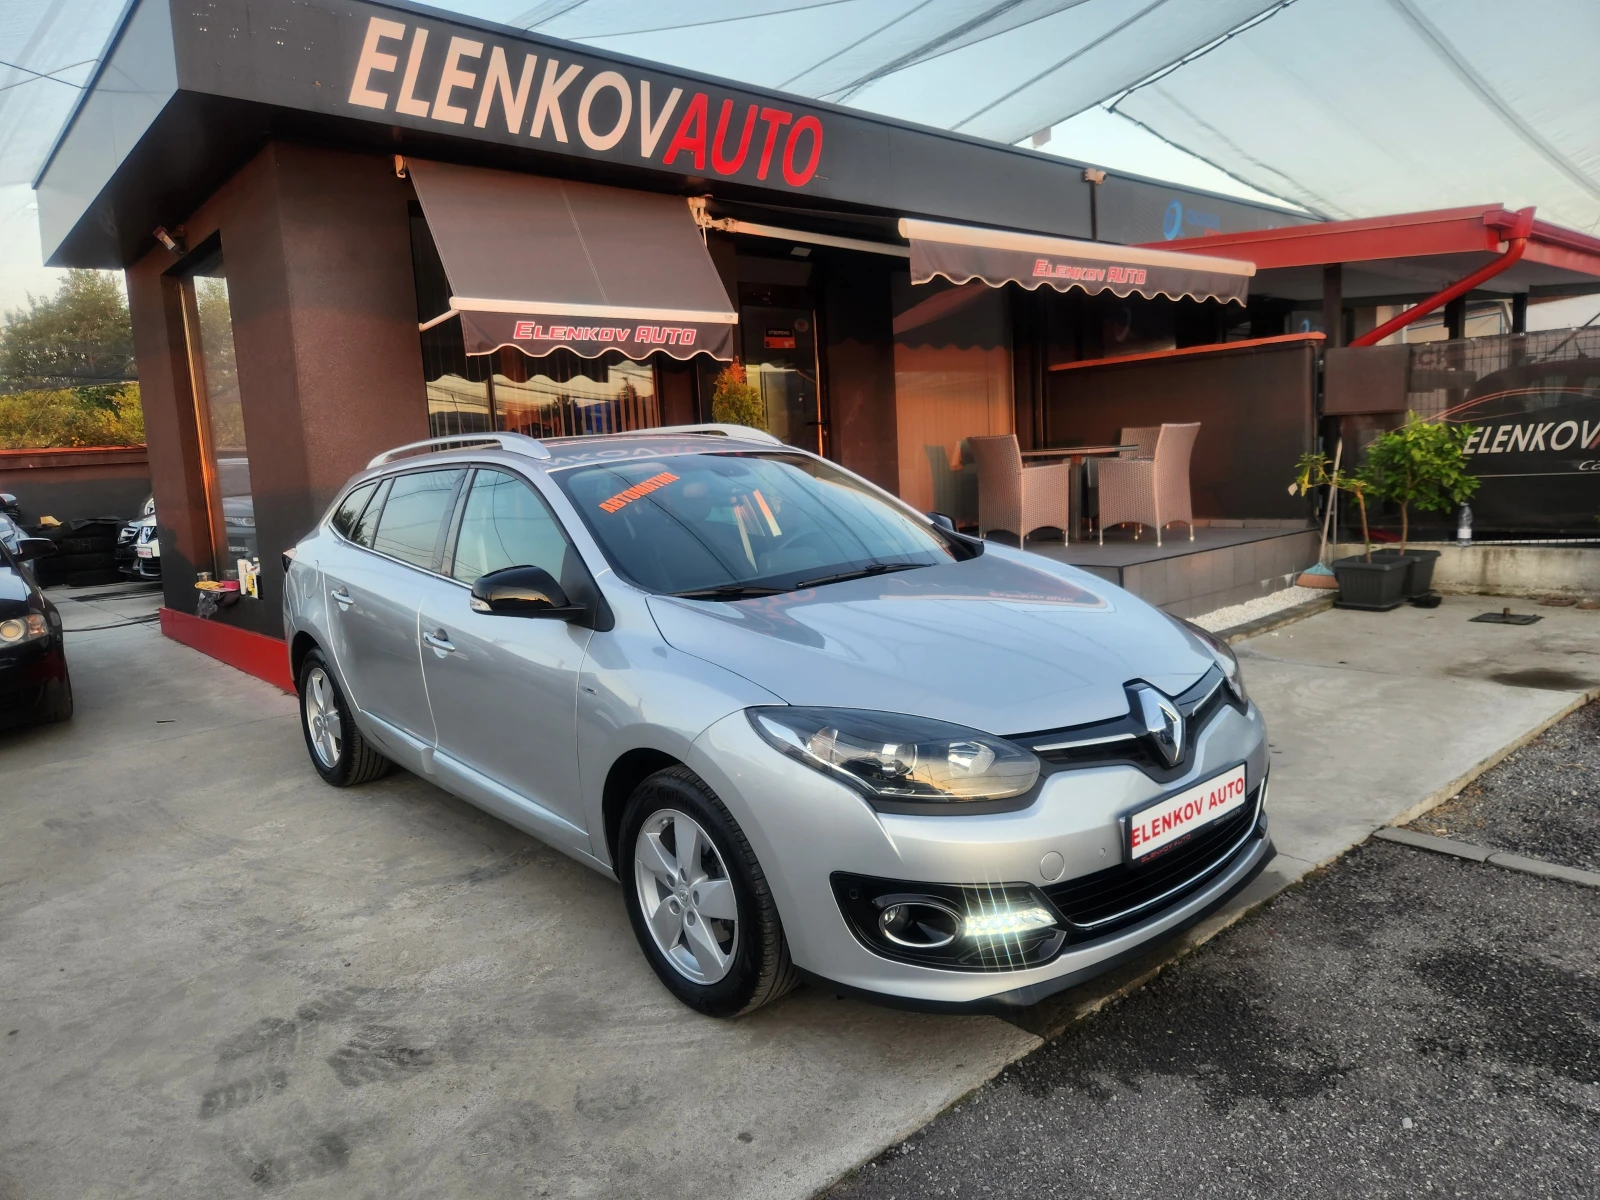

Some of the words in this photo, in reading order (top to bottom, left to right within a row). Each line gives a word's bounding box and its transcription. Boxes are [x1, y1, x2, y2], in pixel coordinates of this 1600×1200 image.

[1106, 266, 1147, 285] AUTO
[634, 325, 697, 345] AUTO
[1131, 796, 1203, 848] ELENKOV
[1208, 777, 1244, 810] AUTO
